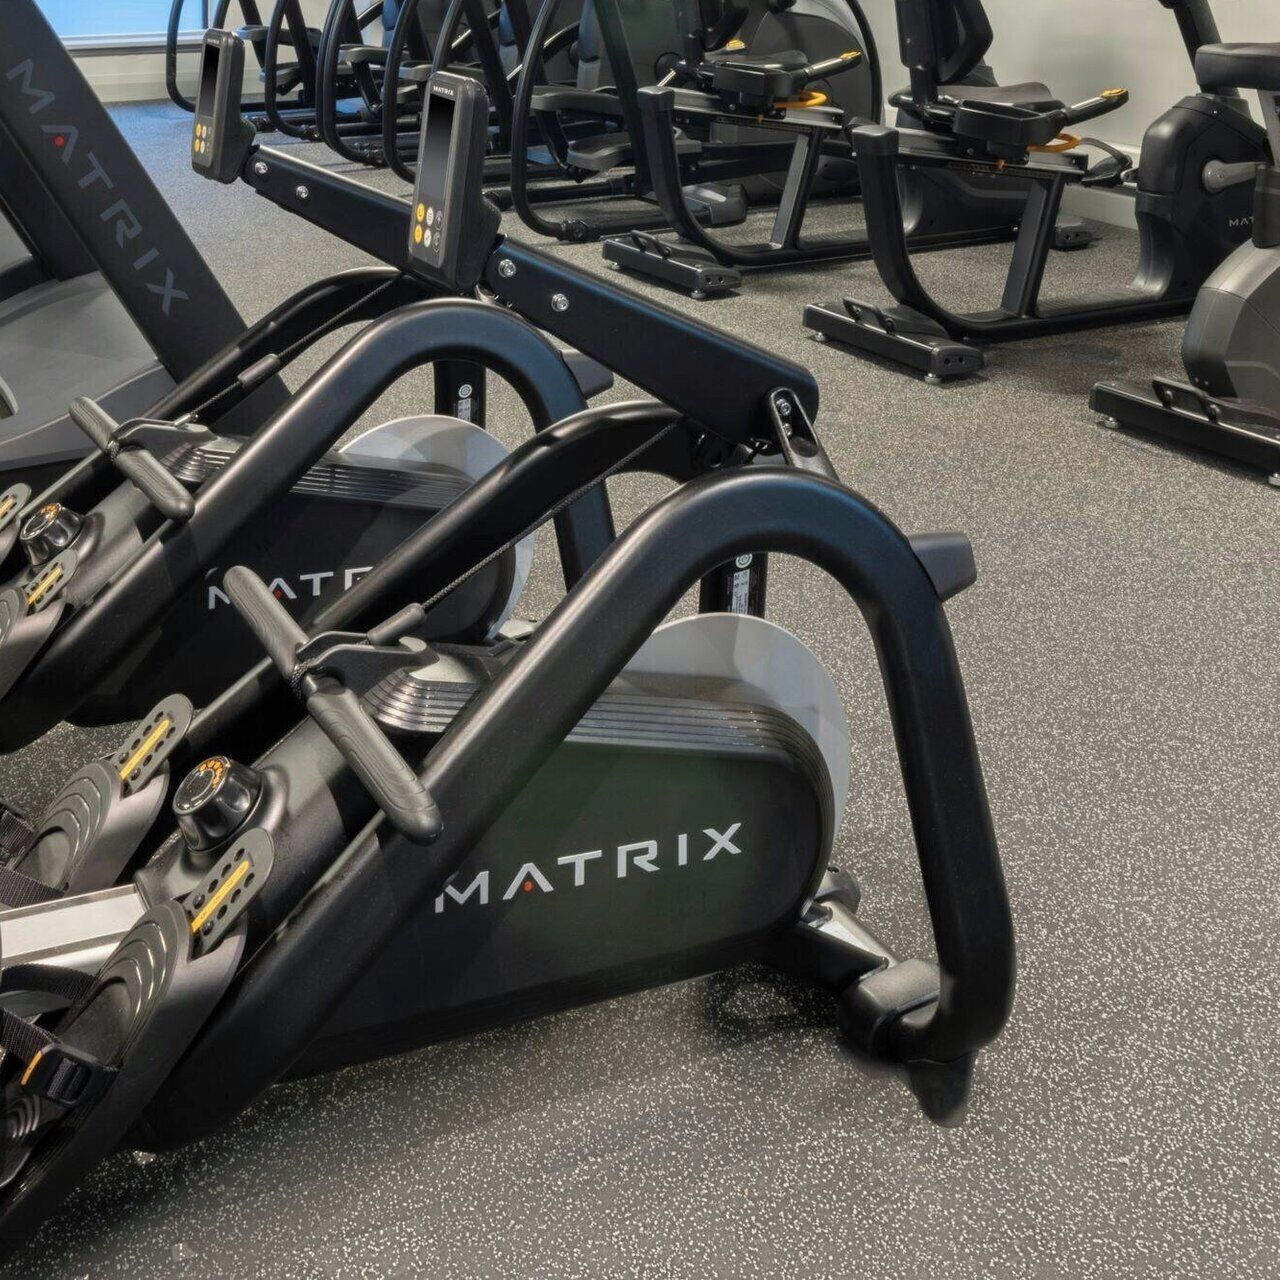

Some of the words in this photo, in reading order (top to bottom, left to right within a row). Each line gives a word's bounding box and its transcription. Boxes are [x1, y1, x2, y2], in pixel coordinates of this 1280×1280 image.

[6, 58, 190, 317] MATRIX
[1228, 216, 1254, 228] MAT
[208, 566, 374, 610] MATR
[434, 822, 742, 914] MATRIX
